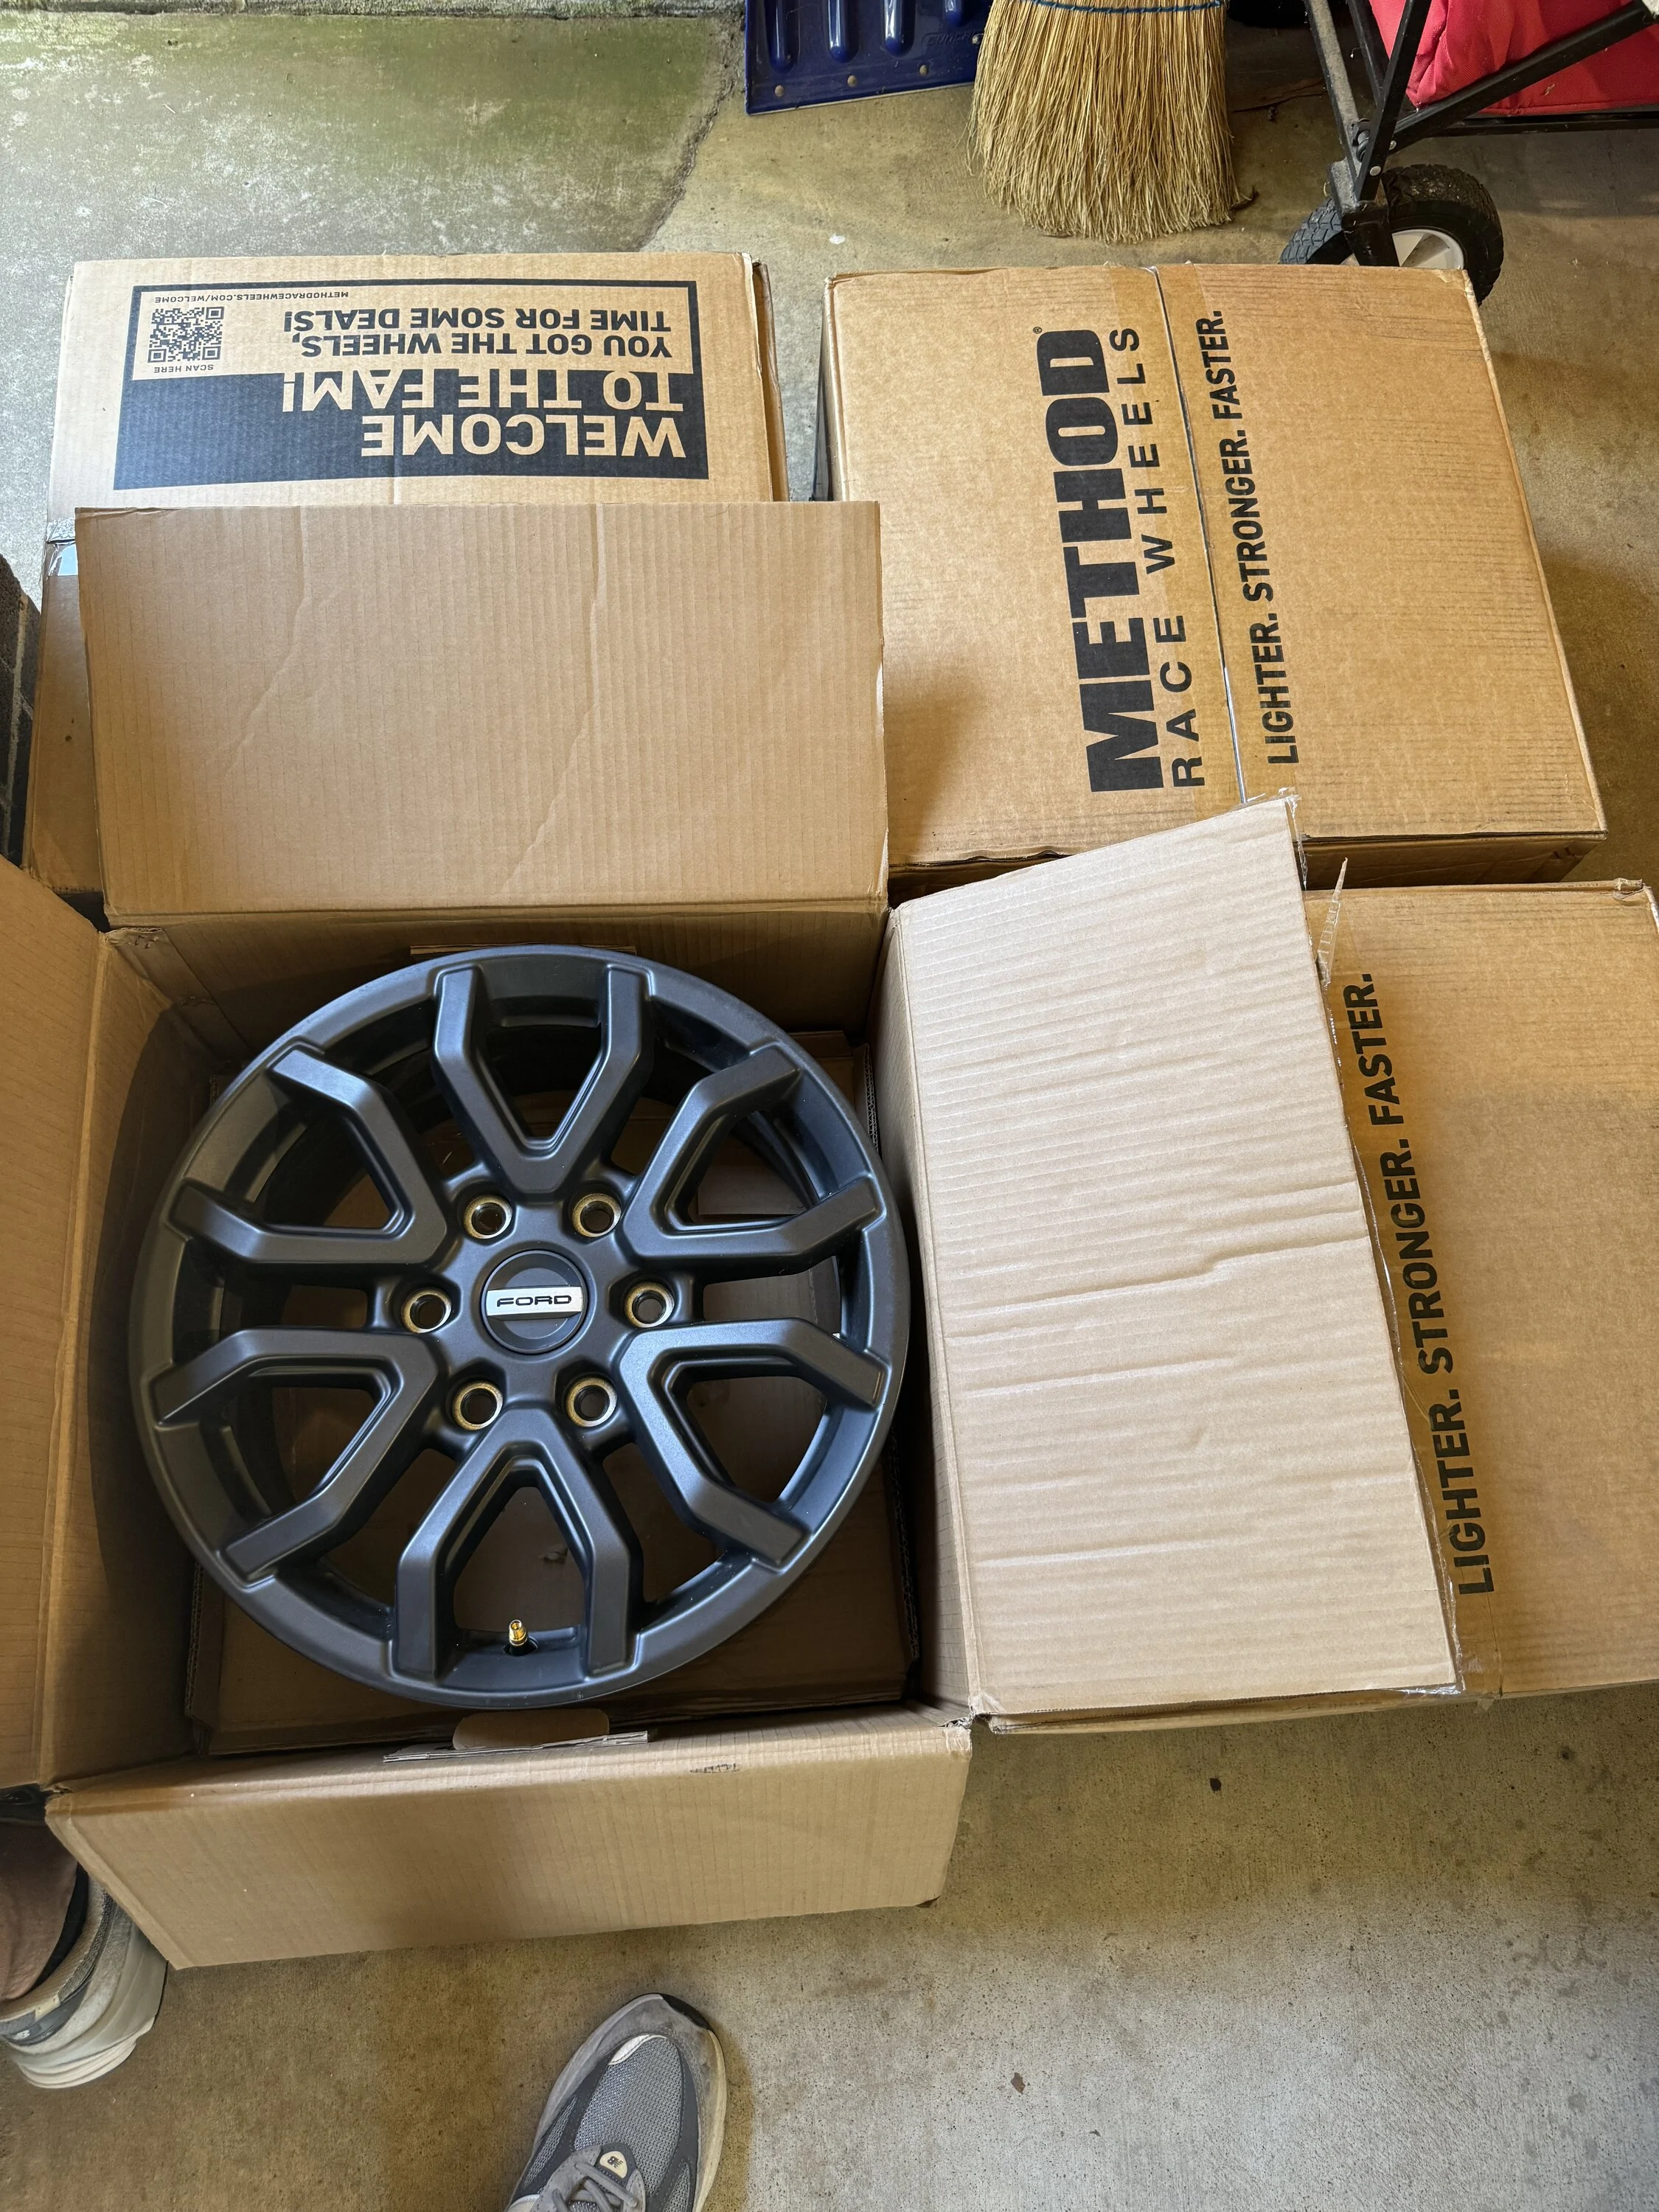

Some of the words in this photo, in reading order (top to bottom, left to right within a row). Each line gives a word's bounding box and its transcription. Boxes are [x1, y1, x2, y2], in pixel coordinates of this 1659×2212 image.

[154, 291, 349, 303] METHODRACEWHEELS.COM/WELCOME
[283, 307, 400, 332] DEALS!
[409, 307, 505, 330] SOME
[515, 308, 580, 330] FOR
[590, 309, 672, 332] TIME
[291, 332, 442, 358] WHEELS,
[451, 332, 518, 355] THE
[525, 333, 593, 355] GOT
[603, 335, 673, 358] YOU
[153, 364, 182, 374] HERE
[185, 364, 214, 372] SCAN
[1194, 310, 1243, 420] FASTER.
[282, 369, 435, 413] FAM!
[458, 369, 582, 409] THE
[602, 370, 684, 412] TO
[361, 413, 686, 459] WELCOME
[1108, 327, 1175, 575] WHEELS
[1219, 429, 1274, 602] STRONGER.
[1036, 329, 1164, 793] METHOD
[1152, 615, 1206, 787] RACE
[1249, 613, 1299, 764] LIGHTER.
[1343, 973, 1405, 1126] FASTER.
[1379, 1138, 1453, 1374] STRONGER.
[496, 1295, 572, 1307] FORD
[1428, 1388, 1495, 1595] LIGHTER.
